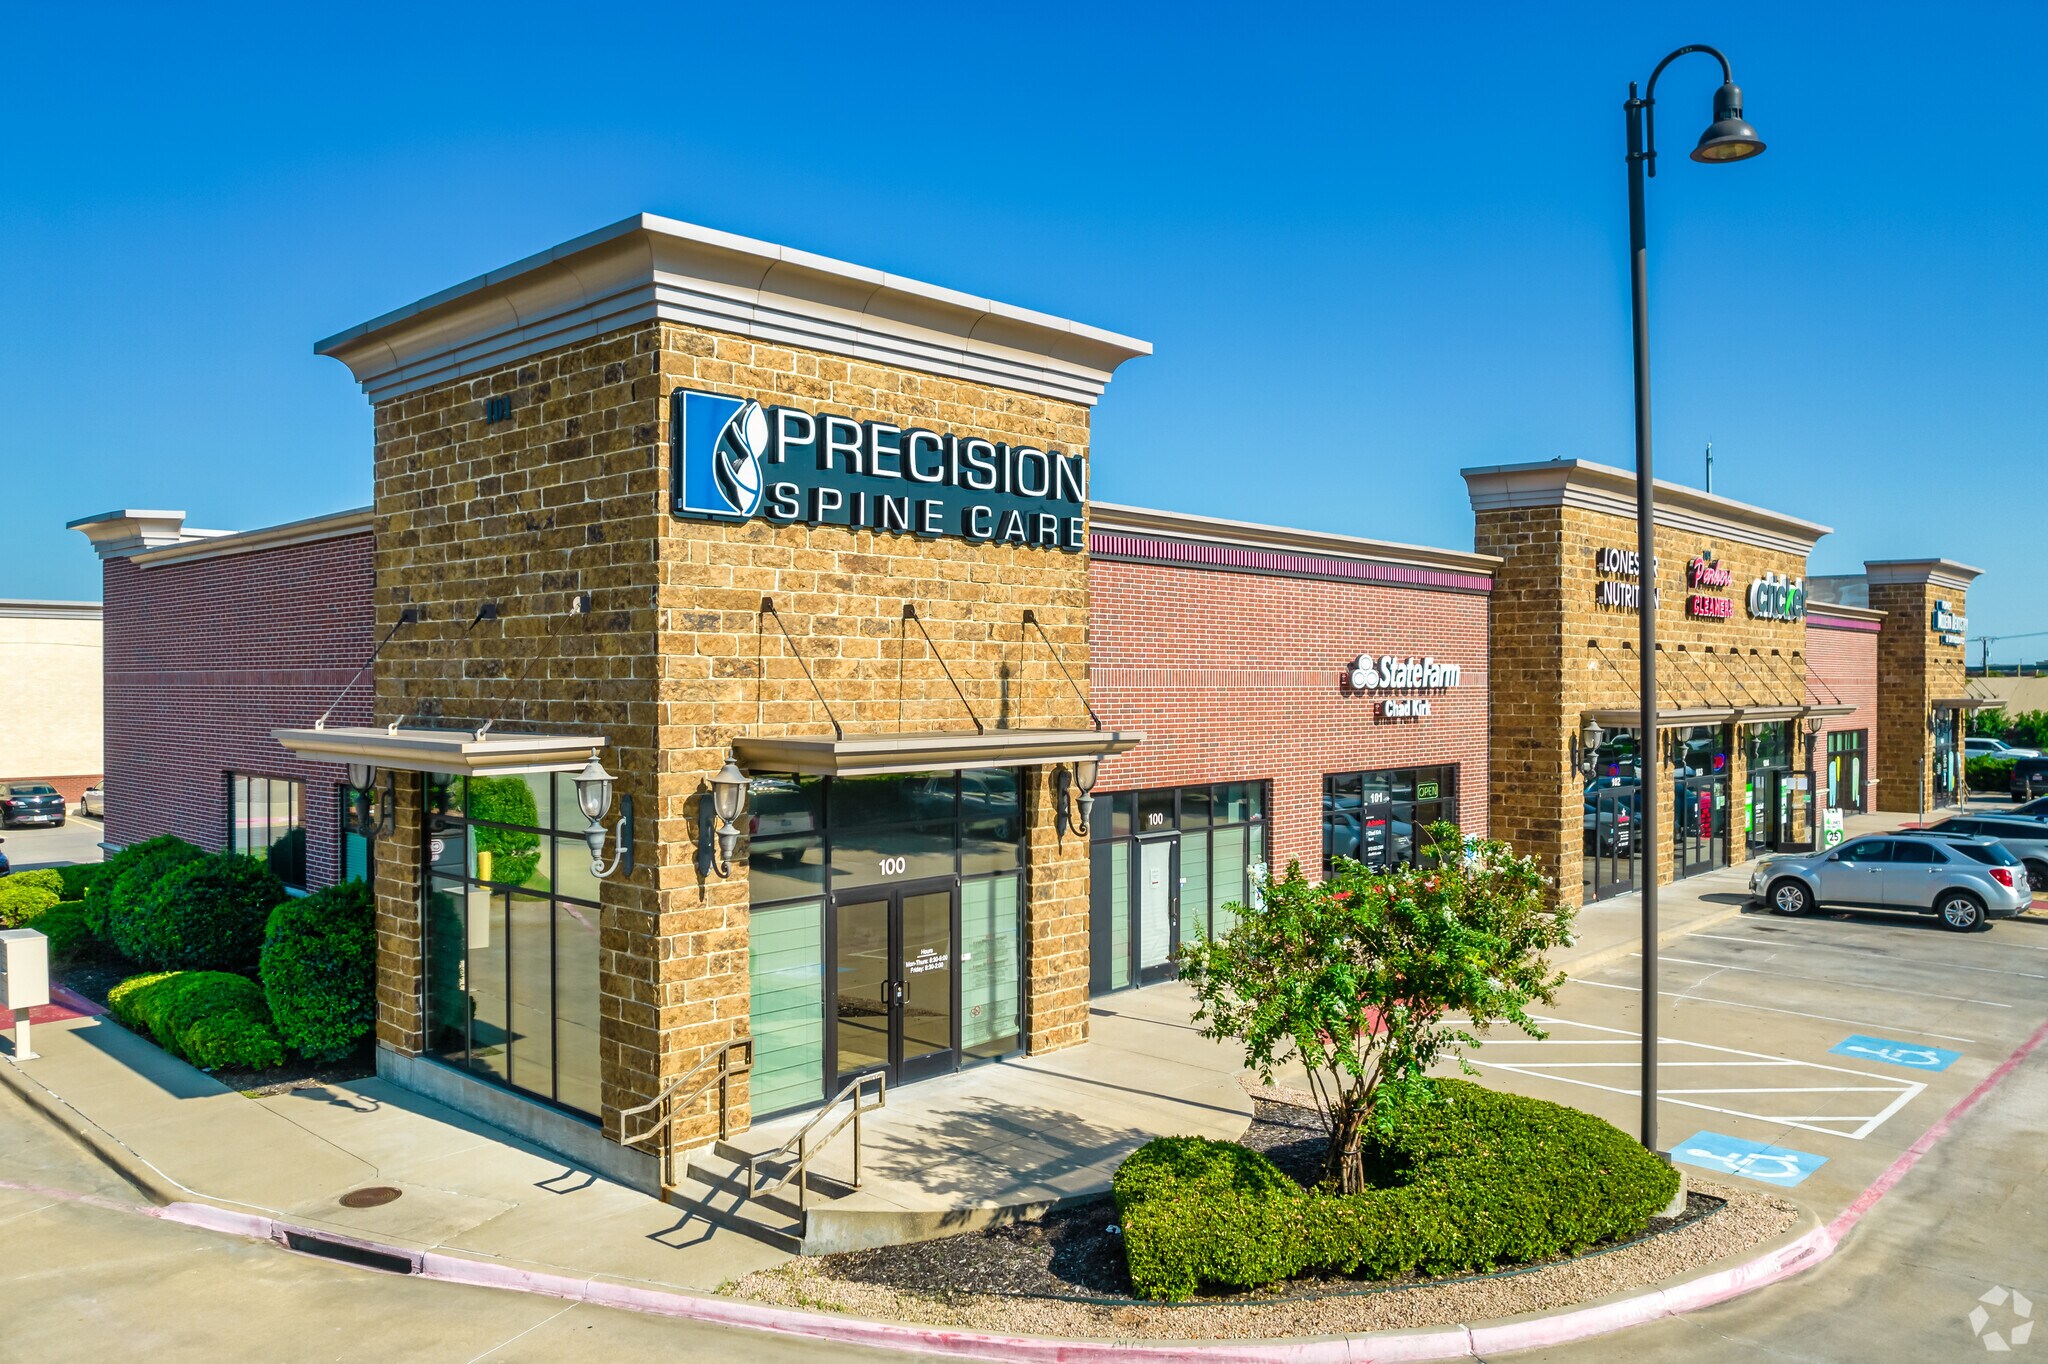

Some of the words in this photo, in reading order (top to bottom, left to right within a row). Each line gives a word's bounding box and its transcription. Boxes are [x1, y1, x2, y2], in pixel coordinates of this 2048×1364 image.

[778, 408, 1085, 503] PRECISION
[774, 482, 944, 534] SPINE
[971, 505, 1085, 547] CARE
[1604, 547, 1658, 577] LONESR
[1604, 581, 1659, 610] NUTRITN
[1693, 595, 1735, 618] CLEANERS
[1385, 700, 1410, 717] Chad
[1370, 792, 1383, 804] 101
[1419, 786, 1437, 797] OPEN
[1149, 813, 1163, 826] 100
[1829, 831, 1839, 842] 25
[878, 857, 906, 875] 100
